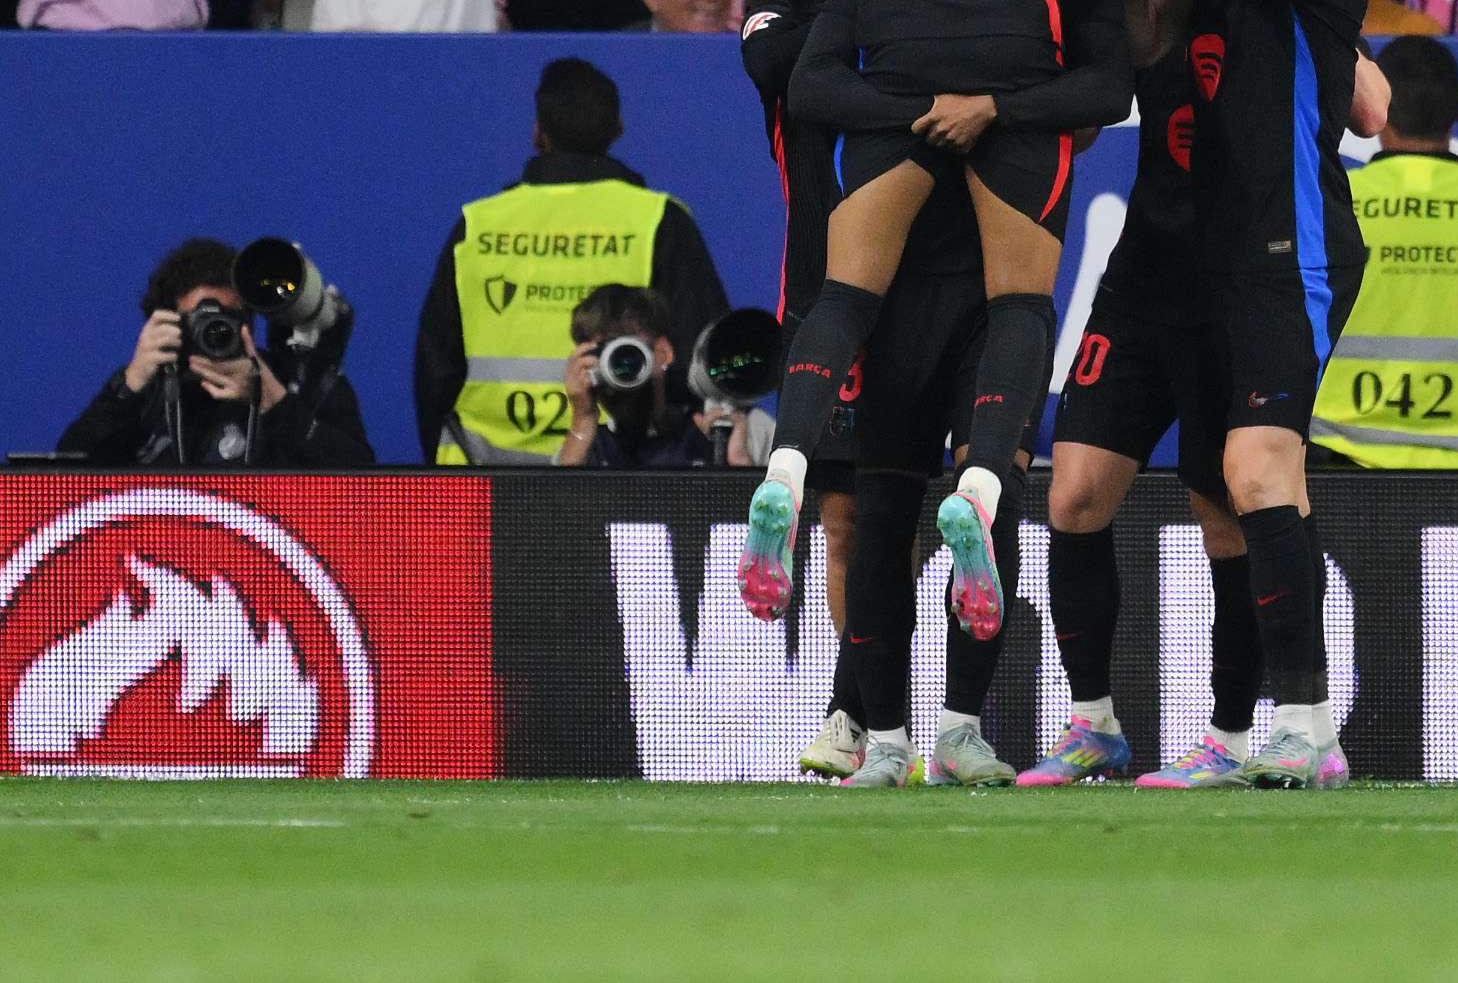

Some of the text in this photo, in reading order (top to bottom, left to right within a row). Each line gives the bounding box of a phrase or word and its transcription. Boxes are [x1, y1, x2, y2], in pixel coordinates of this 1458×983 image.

[478, 232, 635, 258] SEGURETAT
[525, 284, 597, 303] PROTE
[1068, 333, 1112, 386] 0
[1352, 370, 1454, 420] 042
